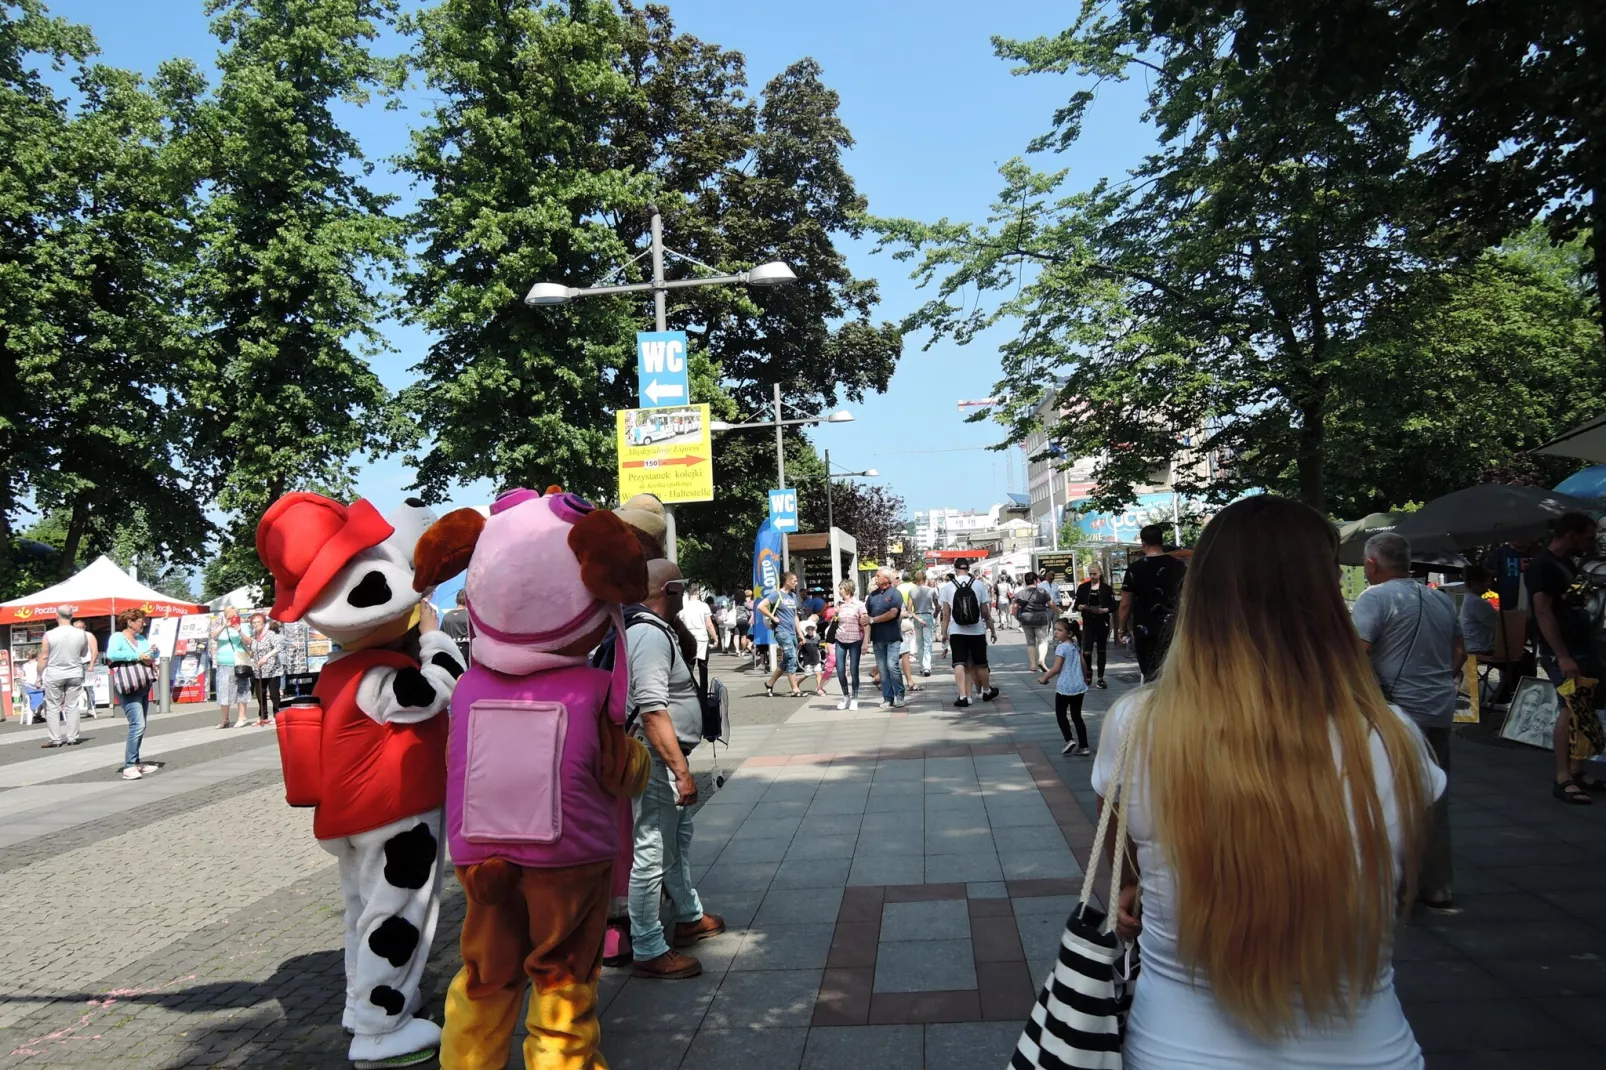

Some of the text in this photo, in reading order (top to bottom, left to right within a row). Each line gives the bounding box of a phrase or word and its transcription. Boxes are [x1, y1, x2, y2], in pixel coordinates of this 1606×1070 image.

[641, 340, 683, 373] WC
[628, 468, 703, 482] Przystanek kolejki
[669, 488, 711, 499] Haltestelle
[771, 494, 794, 513] WC
[761, 559, 776, 595] LOTTO
[34, 606, 57, 615] Poczta
[172, 605, 188, 615] Polska
